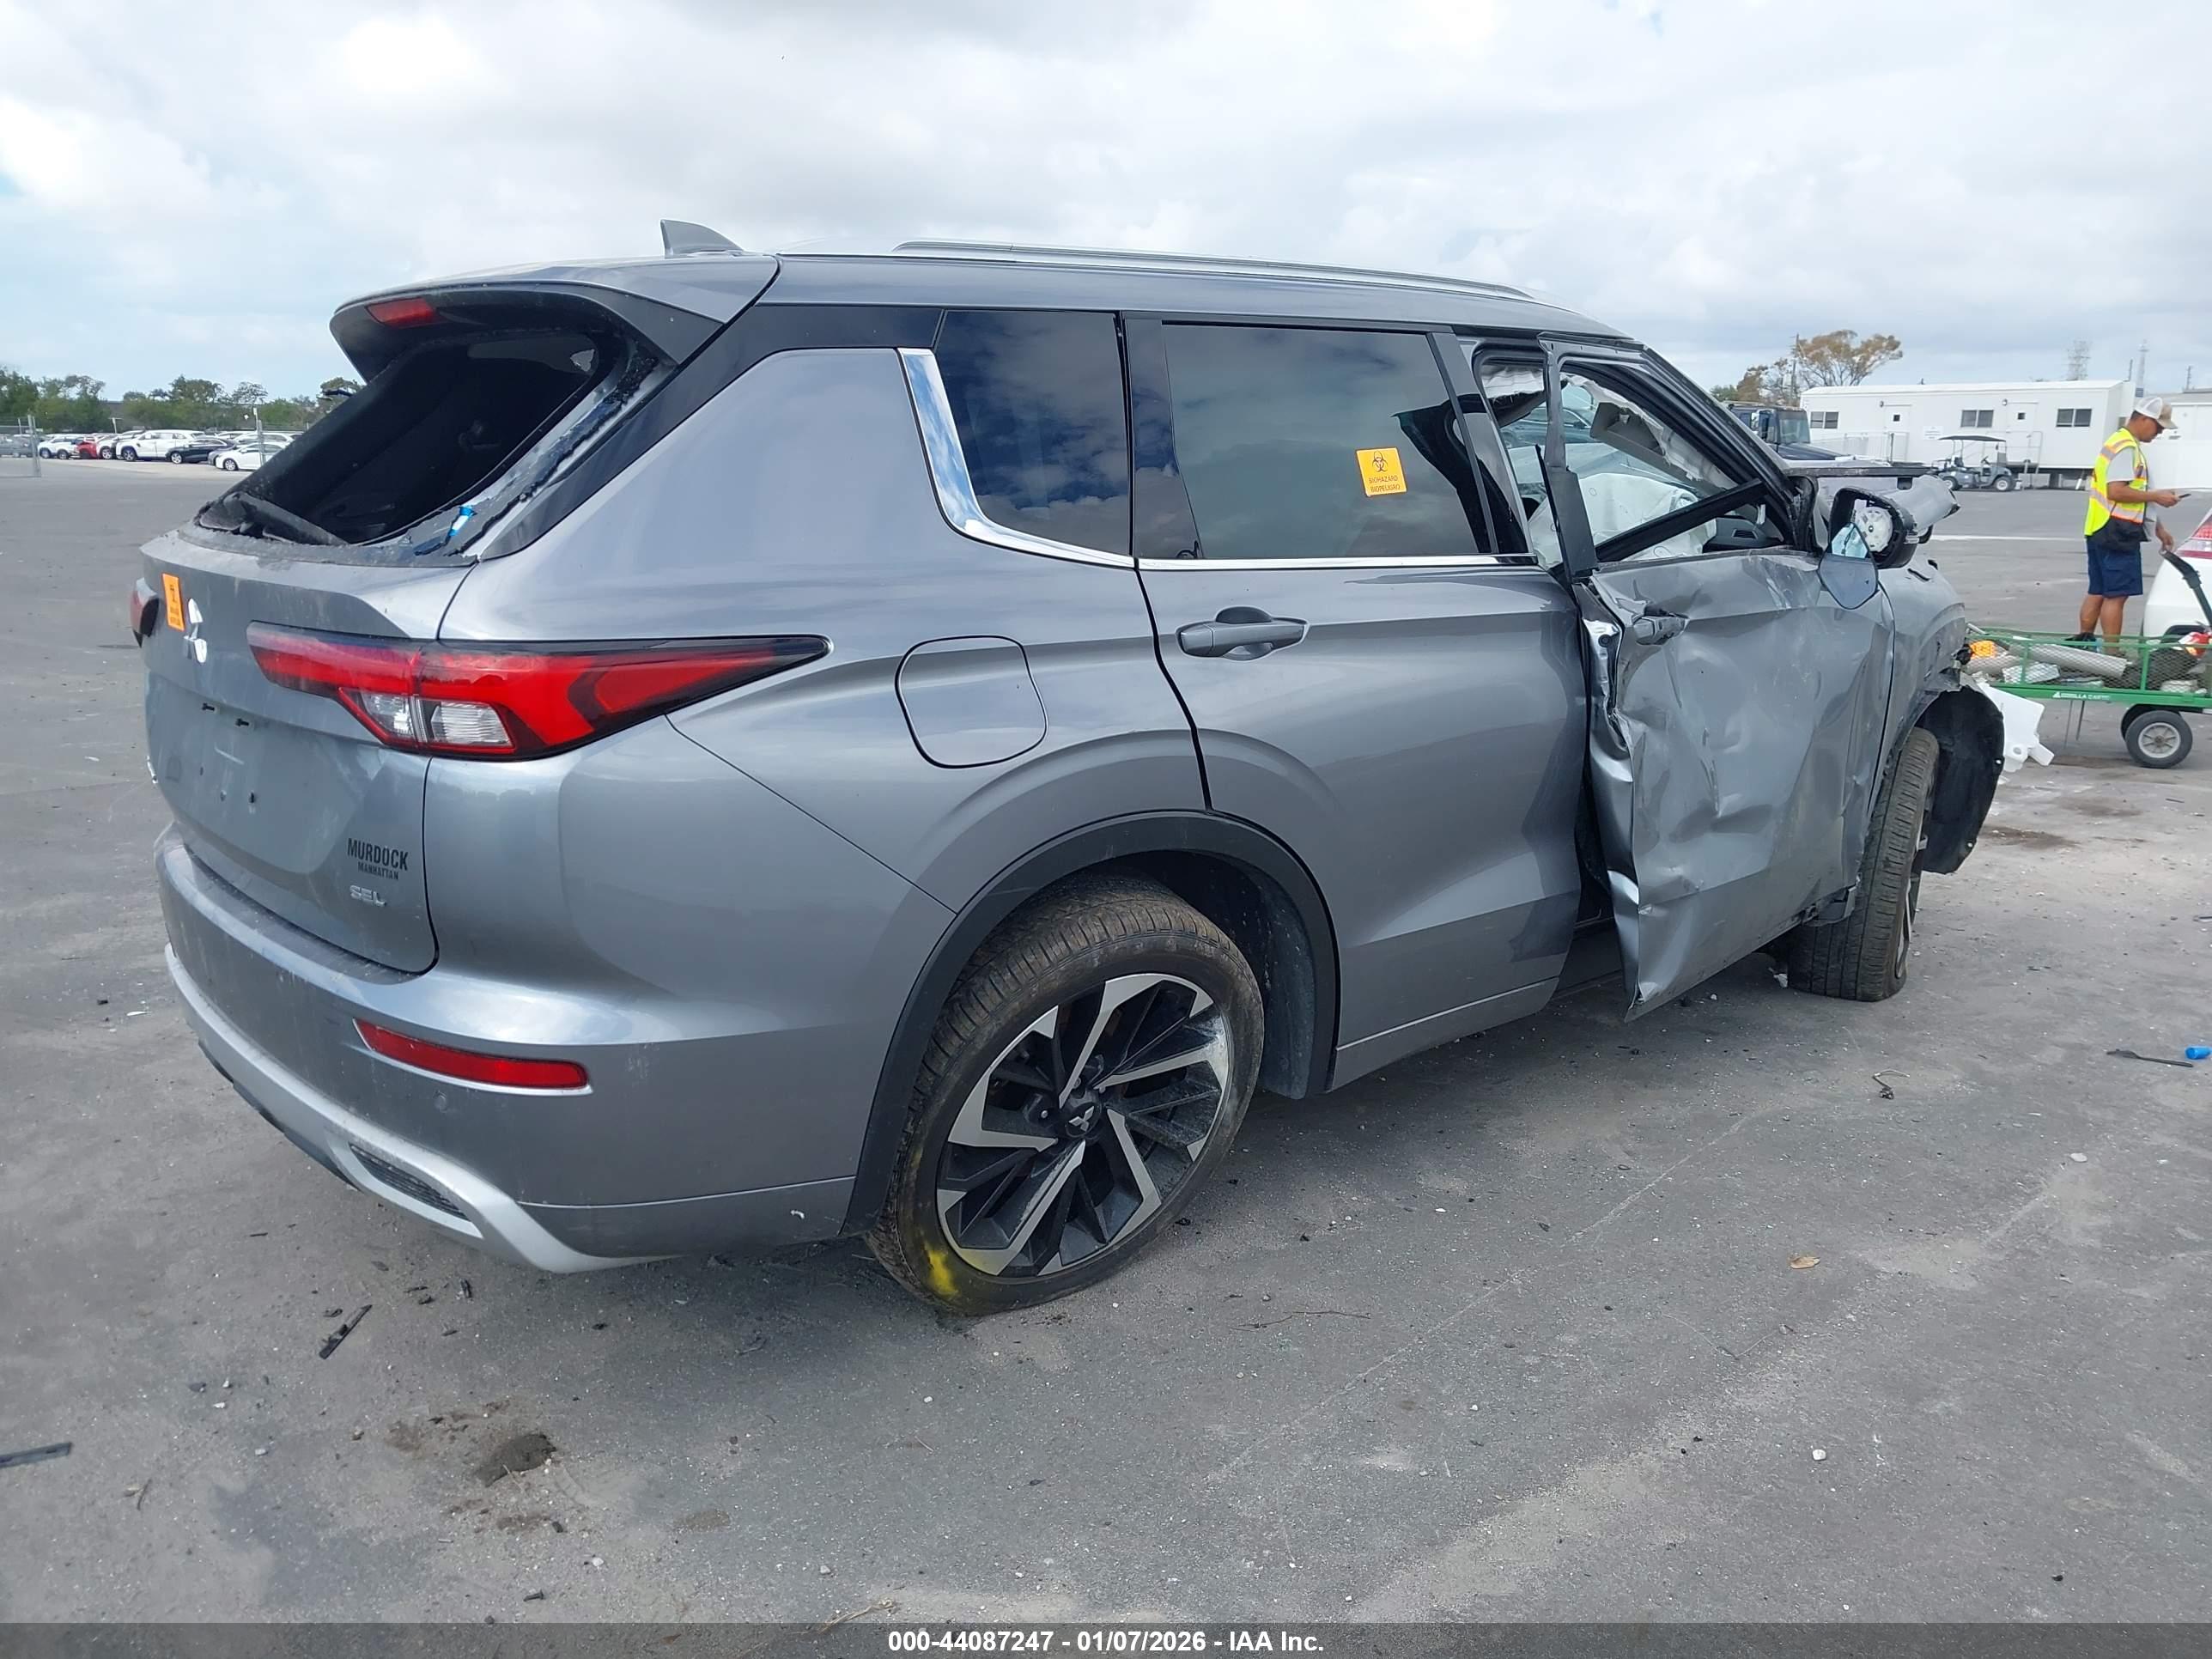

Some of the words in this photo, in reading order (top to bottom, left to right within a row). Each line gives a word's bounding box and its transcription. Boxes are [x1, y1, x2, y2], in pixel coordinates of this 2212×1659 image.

[1369, 475, 1398, 483] BIOHAZARD
[347, 837, 409, 871] MURDOCK
[357, 861, 399, 880] MANHATTAN
[349, 884, 386, 907] SEL
